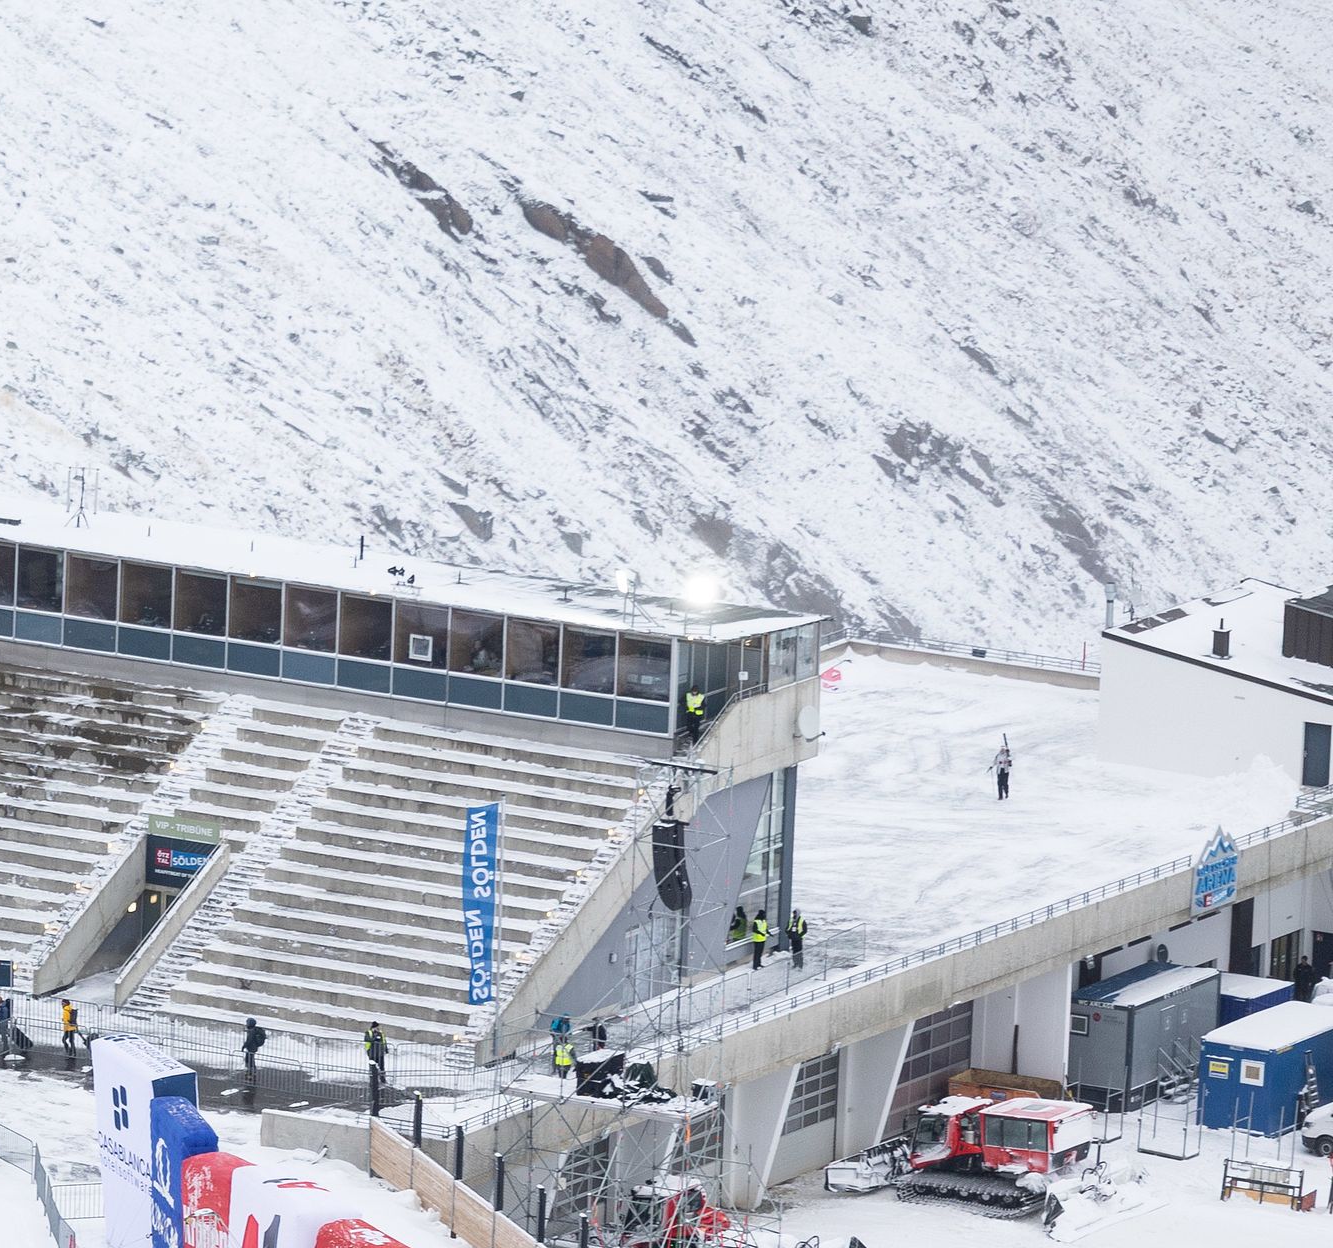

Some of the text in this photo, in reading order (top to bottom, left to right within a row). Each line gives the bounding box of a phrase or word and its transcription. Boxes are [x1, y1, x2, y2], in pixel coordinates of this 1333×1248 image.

[155, 821, 213, 836] VIP TRIBÜNE
[156, 849, 170, 858] ÖTZ
[97, 1130, 152, 1179] CASABLANCA
